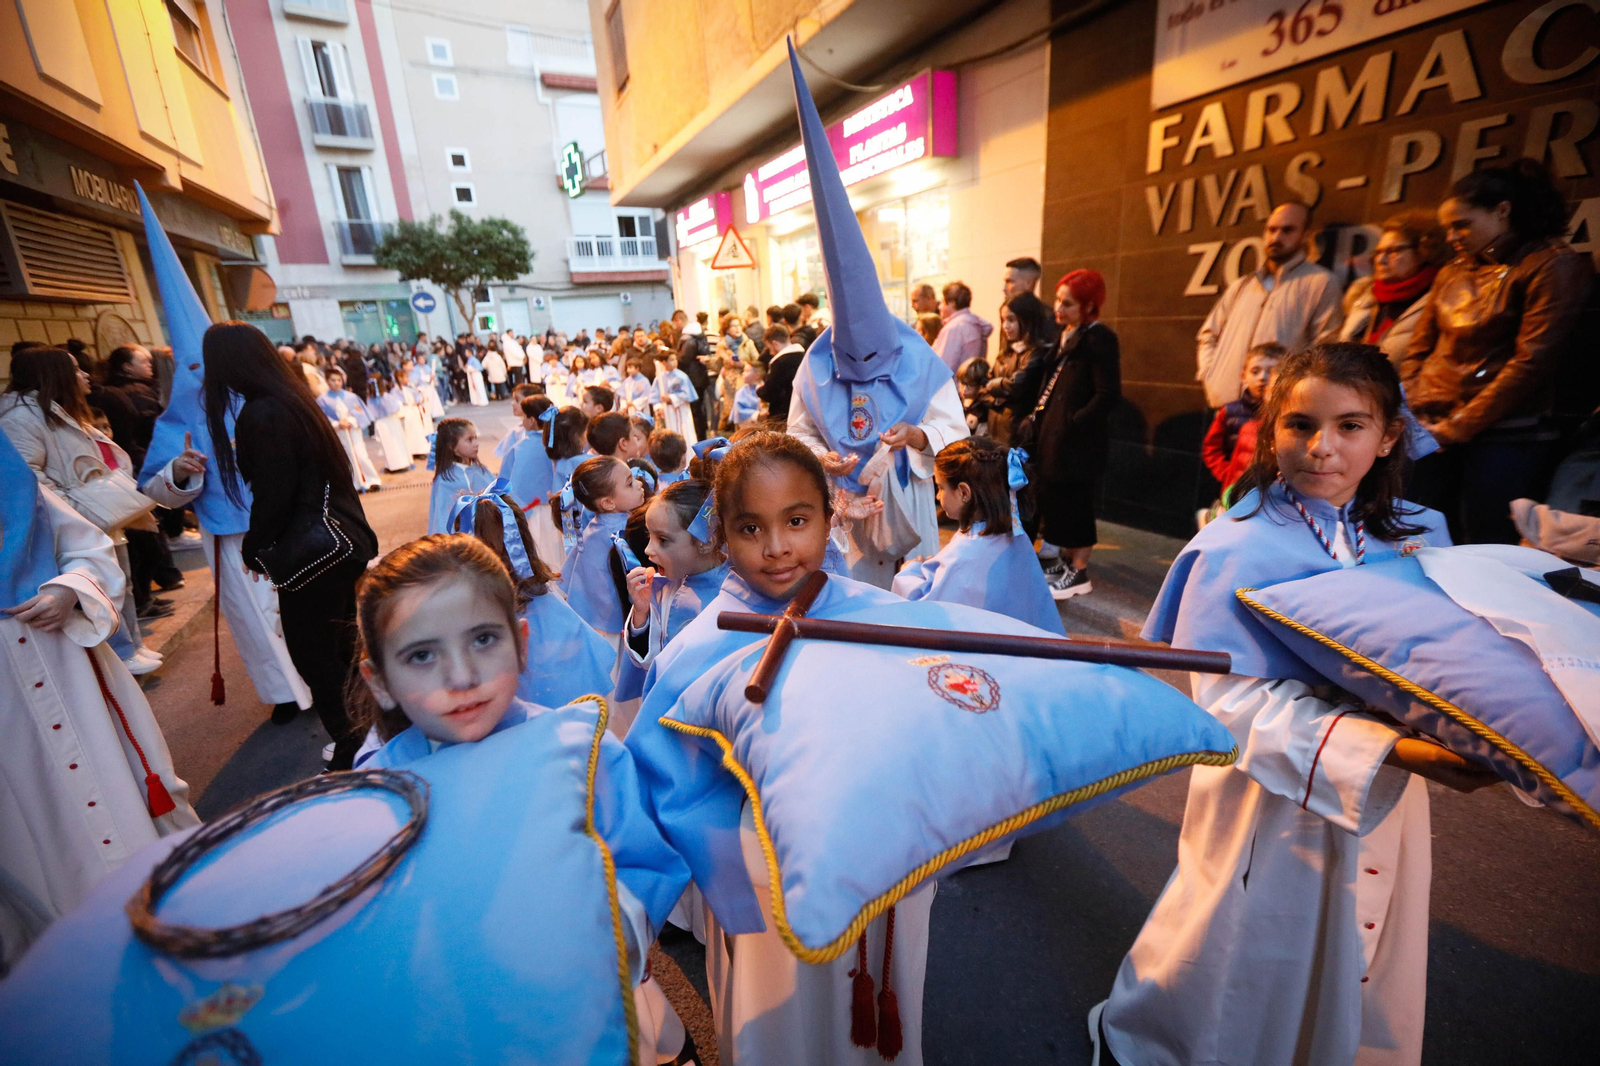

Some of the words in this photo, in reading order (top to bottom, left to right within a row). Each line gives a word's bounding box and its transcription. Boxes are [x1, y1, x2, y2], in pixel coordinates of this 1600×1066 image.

[1261, 0, 1343, 57] 365
[1146, 0, 1600, 175] FARMAC
[70, 165, 141, 216] MOBILIARIO
